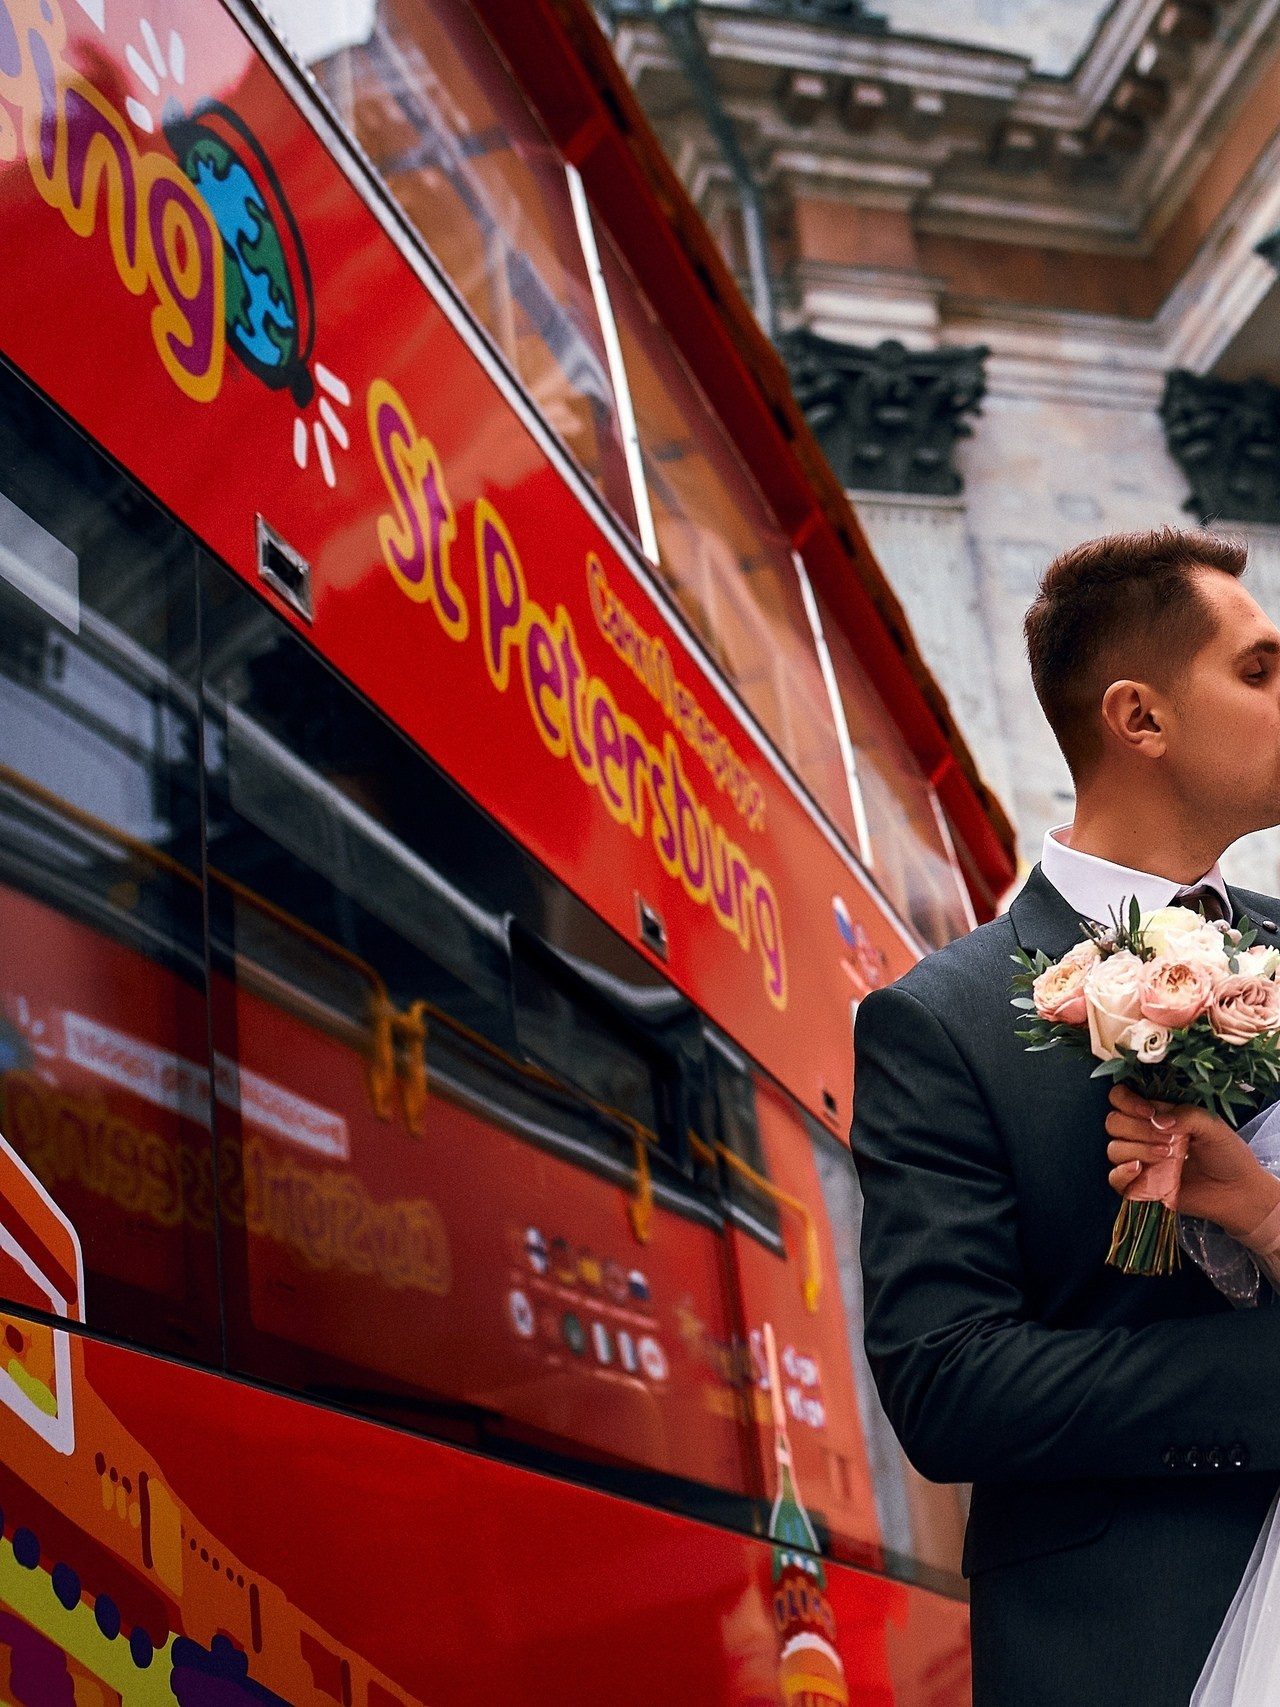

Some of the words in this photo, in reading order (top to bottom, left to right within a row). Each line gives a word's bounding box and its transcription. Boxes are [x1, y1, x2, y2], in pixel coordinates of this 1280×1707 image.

[0, 0, 224, 402] ing
[367, 378, 469, 642] St
[474, 498, 787, 1010] Petersburg
